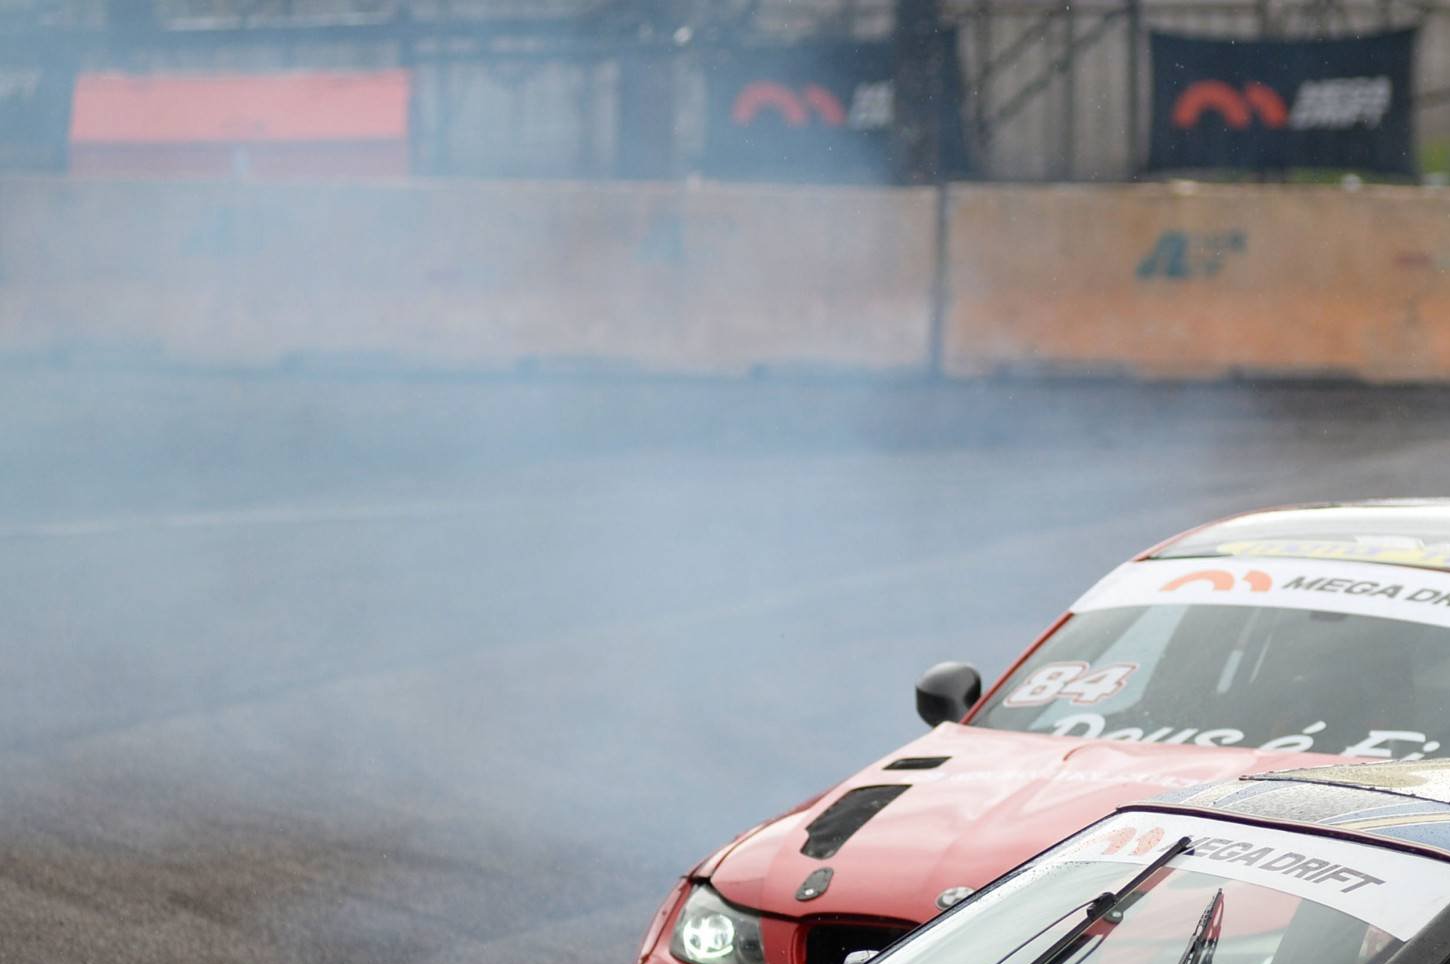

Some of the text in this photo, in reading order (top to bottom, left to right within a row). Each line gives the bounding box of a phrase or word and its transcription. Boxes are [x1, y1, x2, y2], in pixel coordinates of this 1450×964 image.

[1283, 575, 1397, 599] MEGA
[1003, 660, 1139, 707] 84
[1258, 847, 1387, 894] DRIFT
